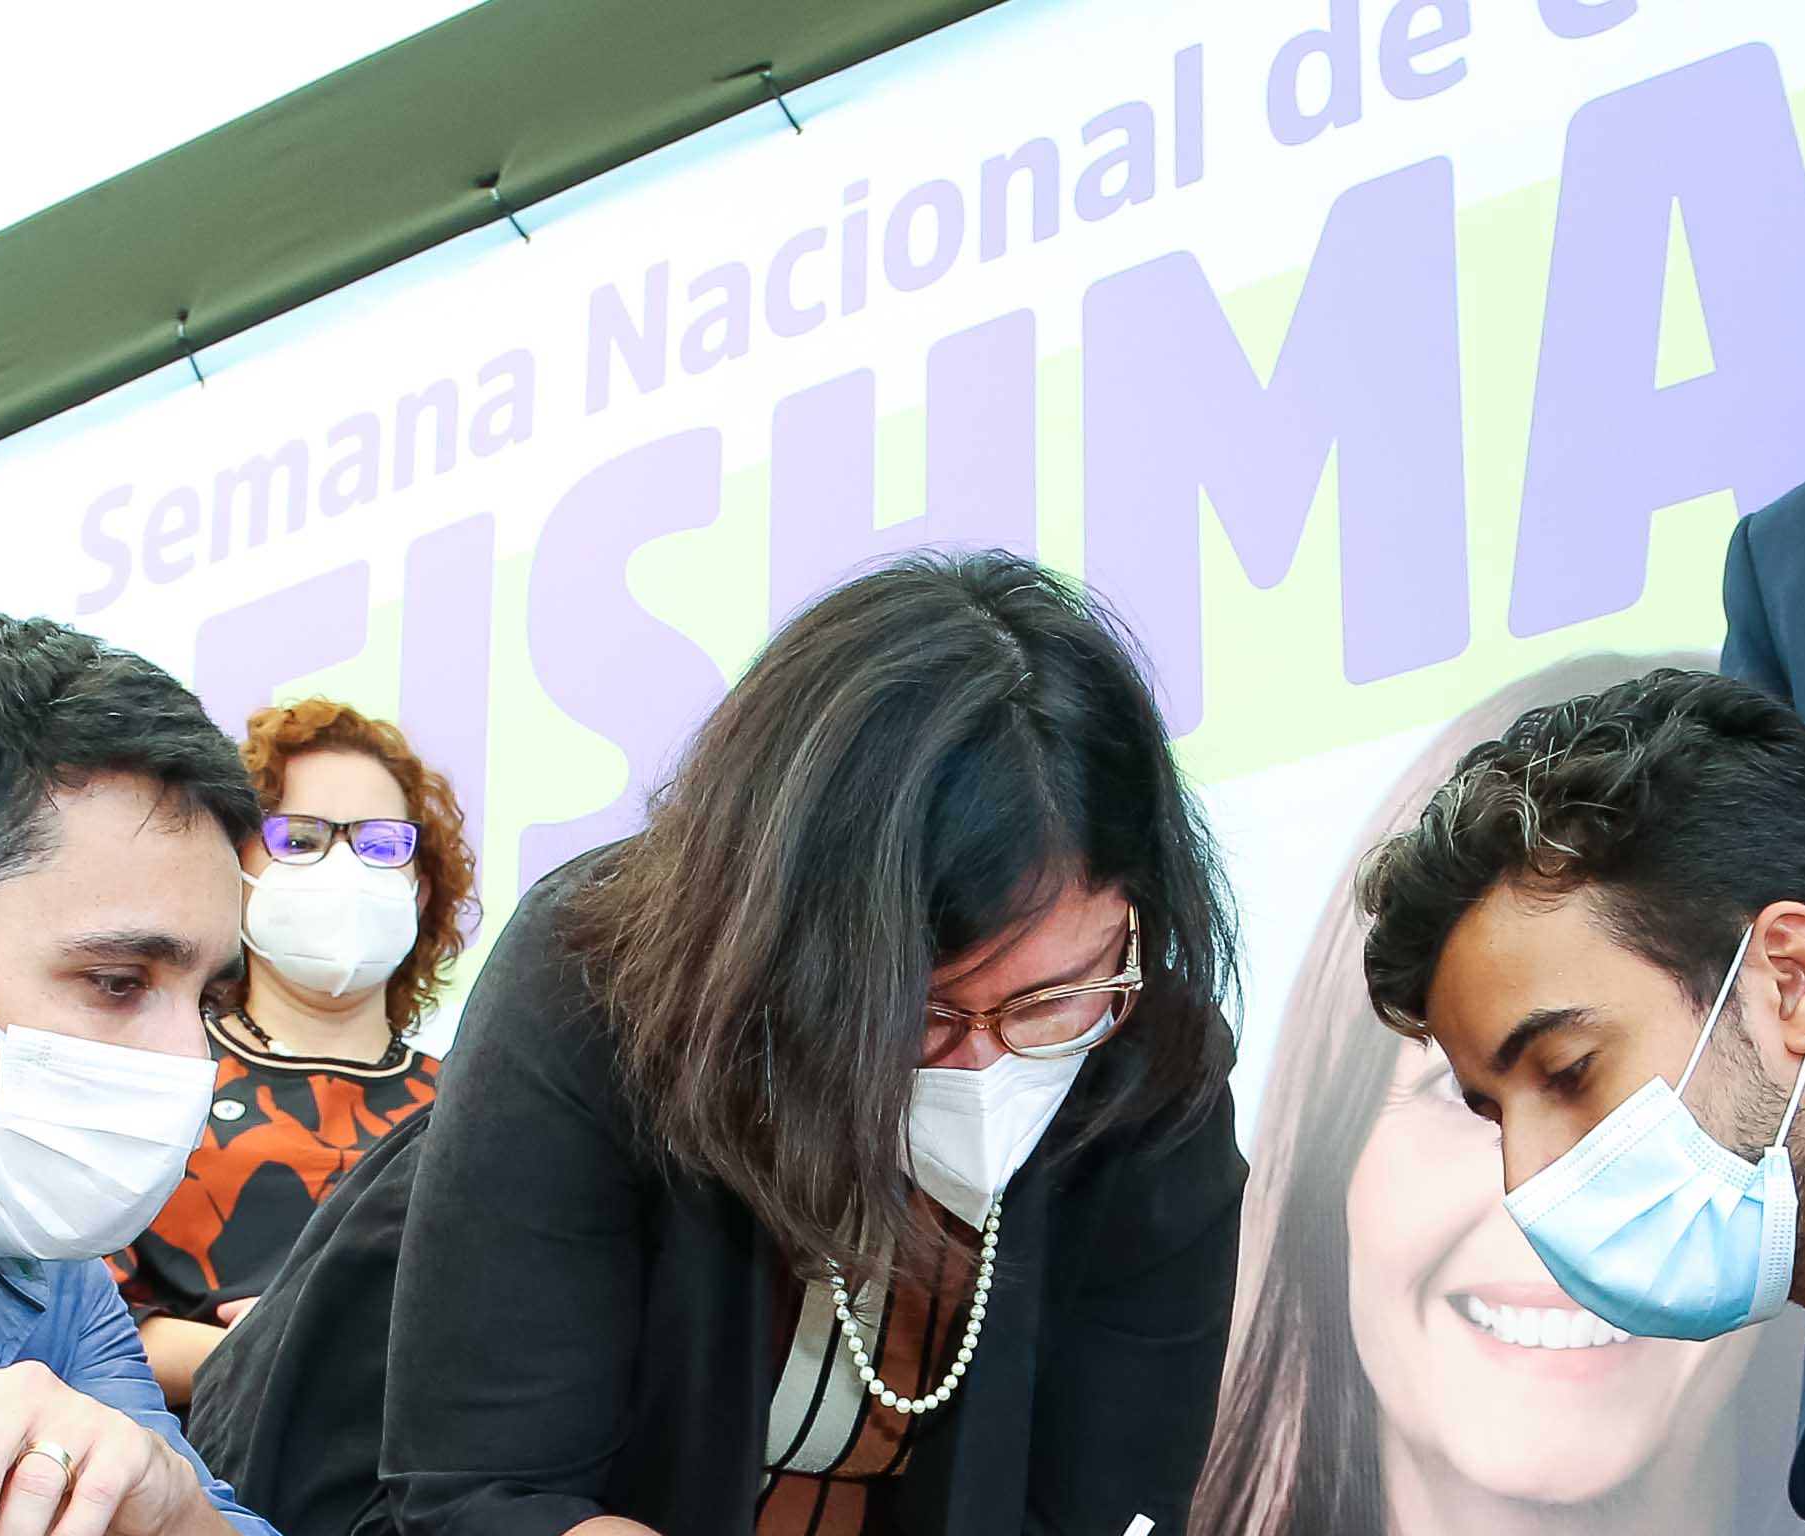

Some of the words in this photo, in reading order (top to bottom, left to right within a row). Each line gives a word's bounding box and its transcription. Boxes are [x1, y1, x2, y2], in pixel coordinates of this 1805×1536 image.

[76, 347, 536, 616] Semana
[584, 43, 1204, 416] Nacional
[1266, 0, 1472, 147] de
